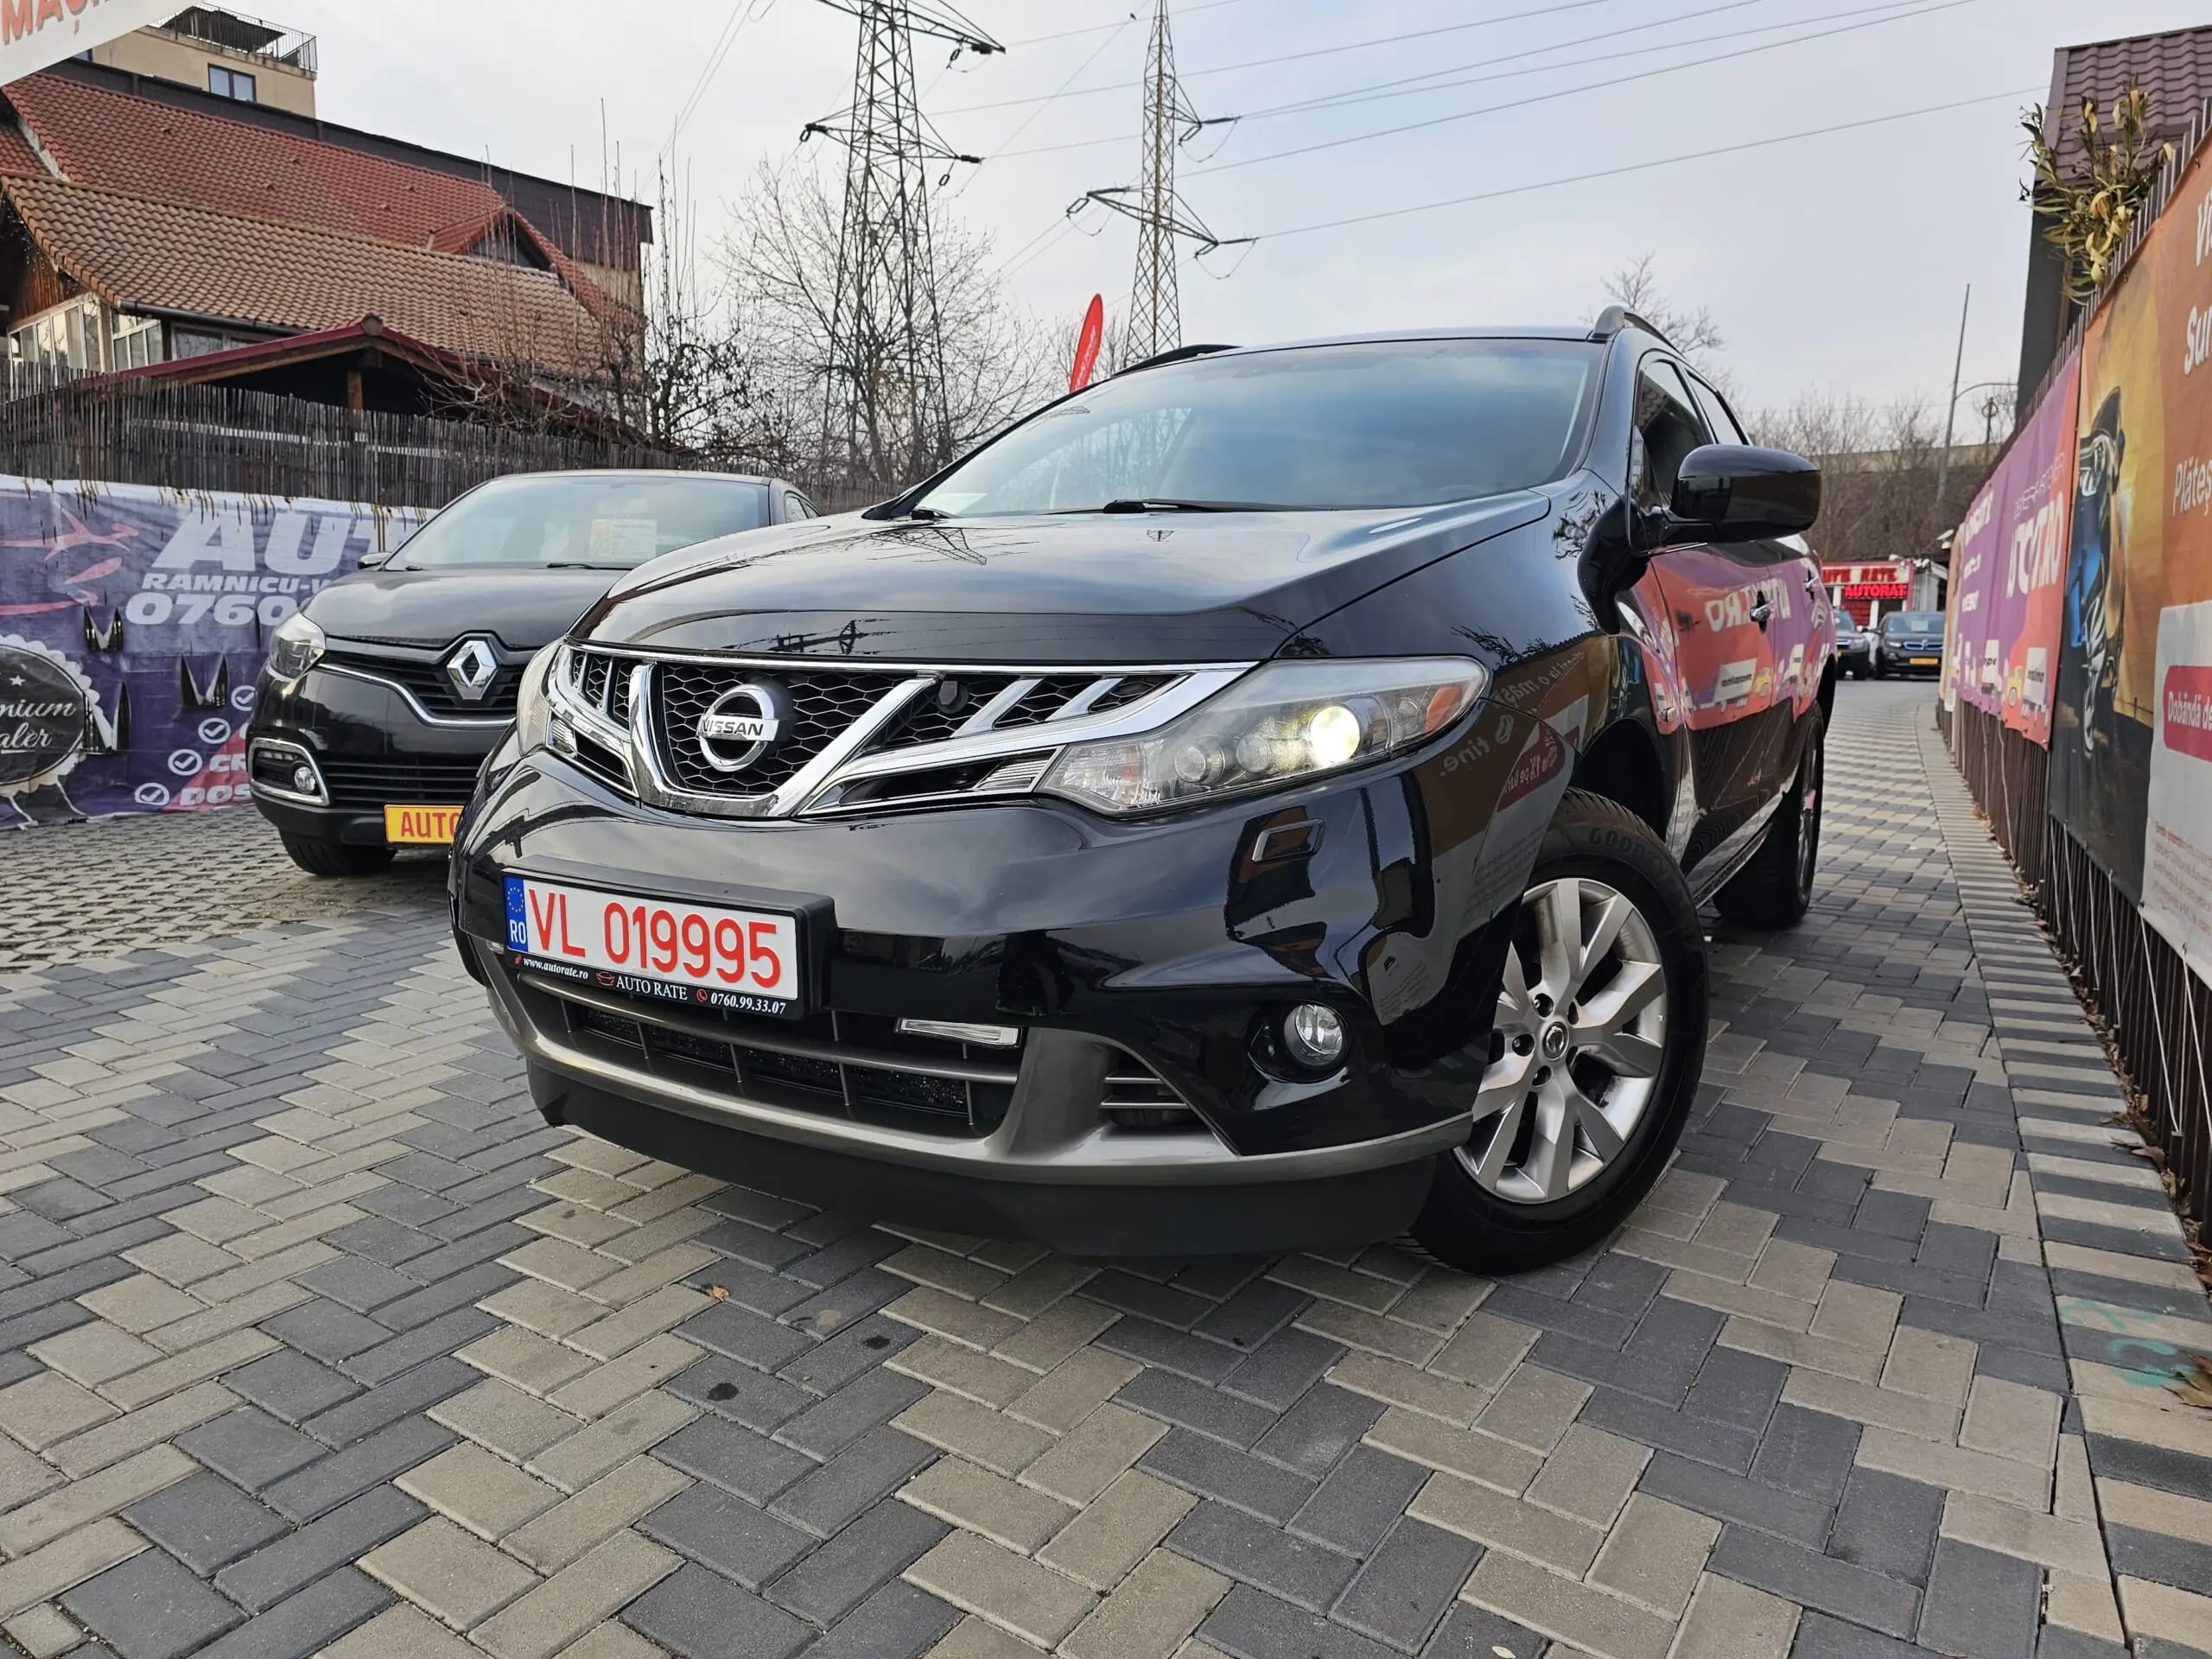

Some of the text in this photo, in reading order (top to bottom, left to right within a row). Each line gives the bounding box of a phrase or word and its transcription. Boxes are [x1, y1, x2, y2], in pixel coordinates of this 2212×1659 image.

[2196, 187, 2212, 268] Vi
[125, 592, 312, 626] 0760
[702, 719, 764, 736] NISSAN
[509, 918, 528, 945] RO
[528, 888, 781, 988] VL 019995
[523, 957, 589, 980] www.autorate.ro
[616, 976, 689, 1001] AUTO RATE
[710, 991, 787, 1015] 0760.99.33.07
